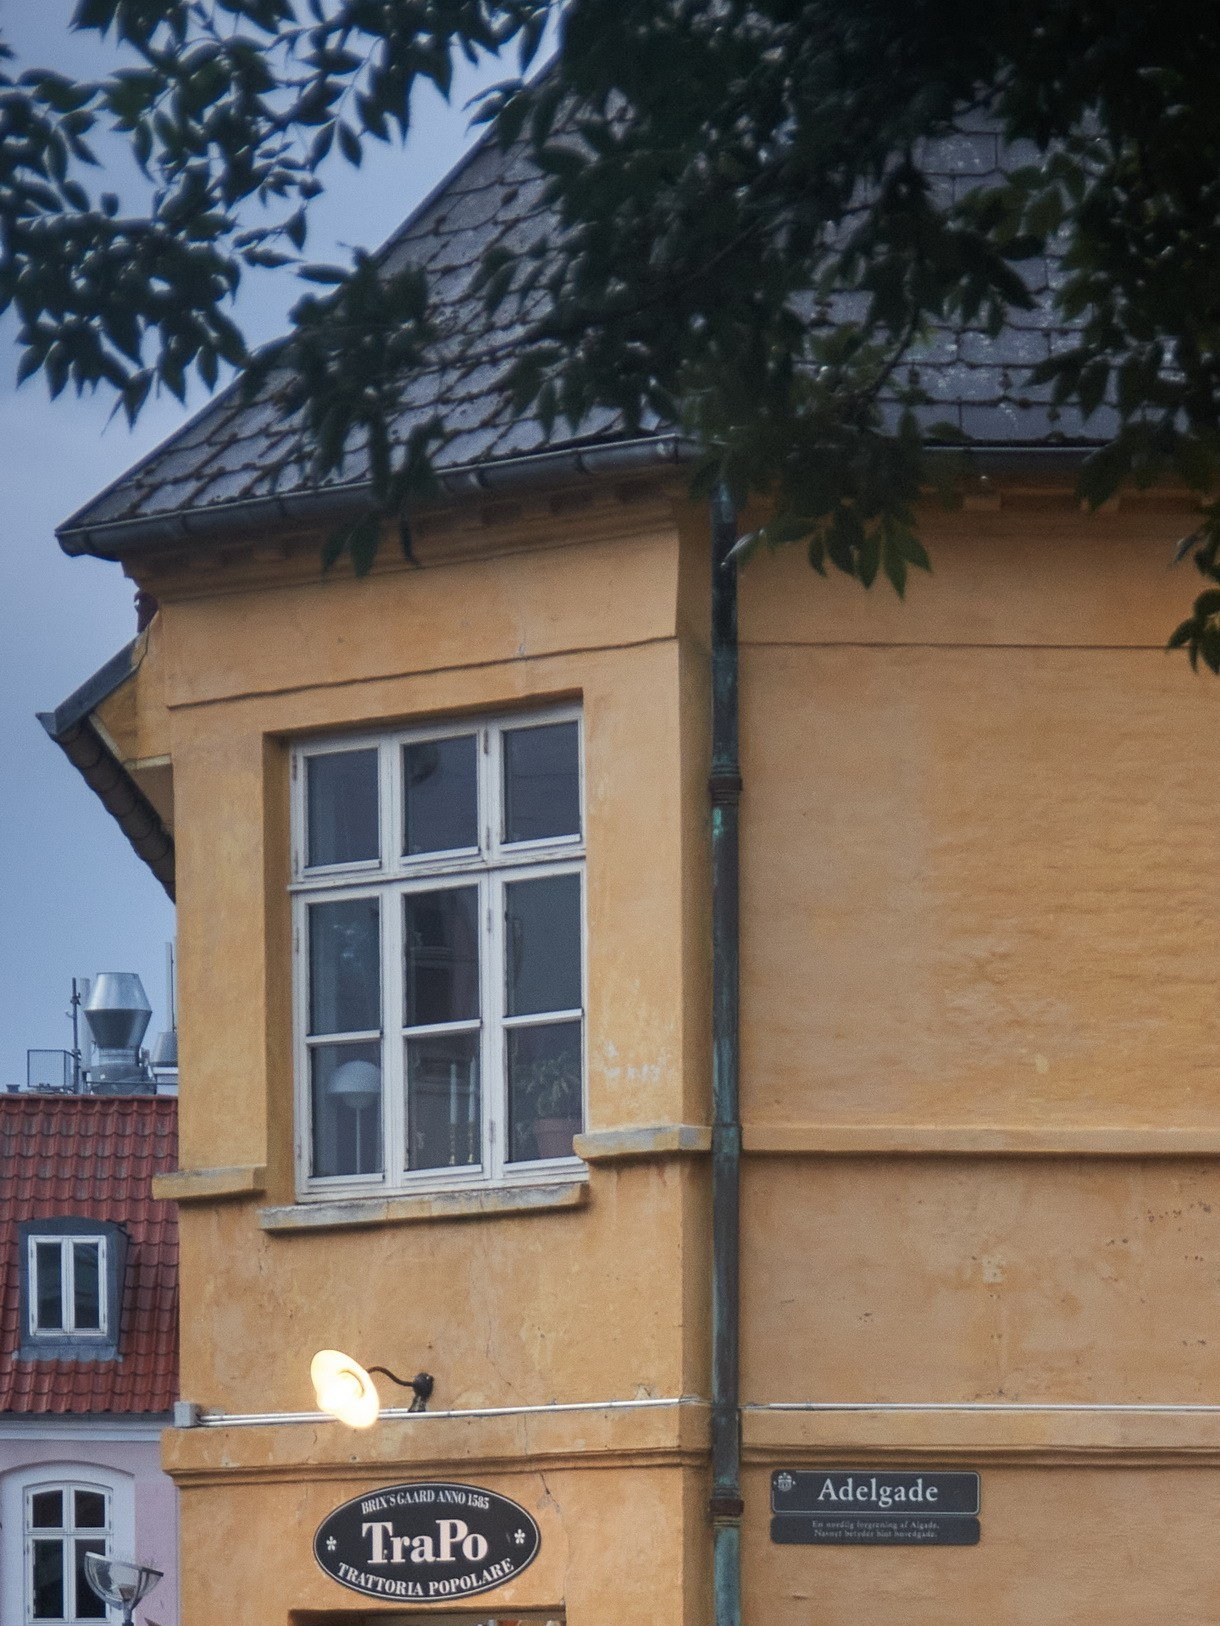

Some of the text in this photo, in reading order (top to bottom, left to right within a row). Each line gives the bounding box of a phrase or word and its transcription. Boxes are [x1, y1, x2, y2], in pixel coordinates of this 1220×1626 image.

[397, 1490, 435, 1505] GAARD
[436, 1490, 466, 1505] ANNO
[467, 1494, 490, 1511] 1585
[817, 1477, 939, 1508] Adelgade
[361, 1519, 489, 1564] TraPo
[337, 1557, 514, 1596] TRATTORIA POPOLARE
